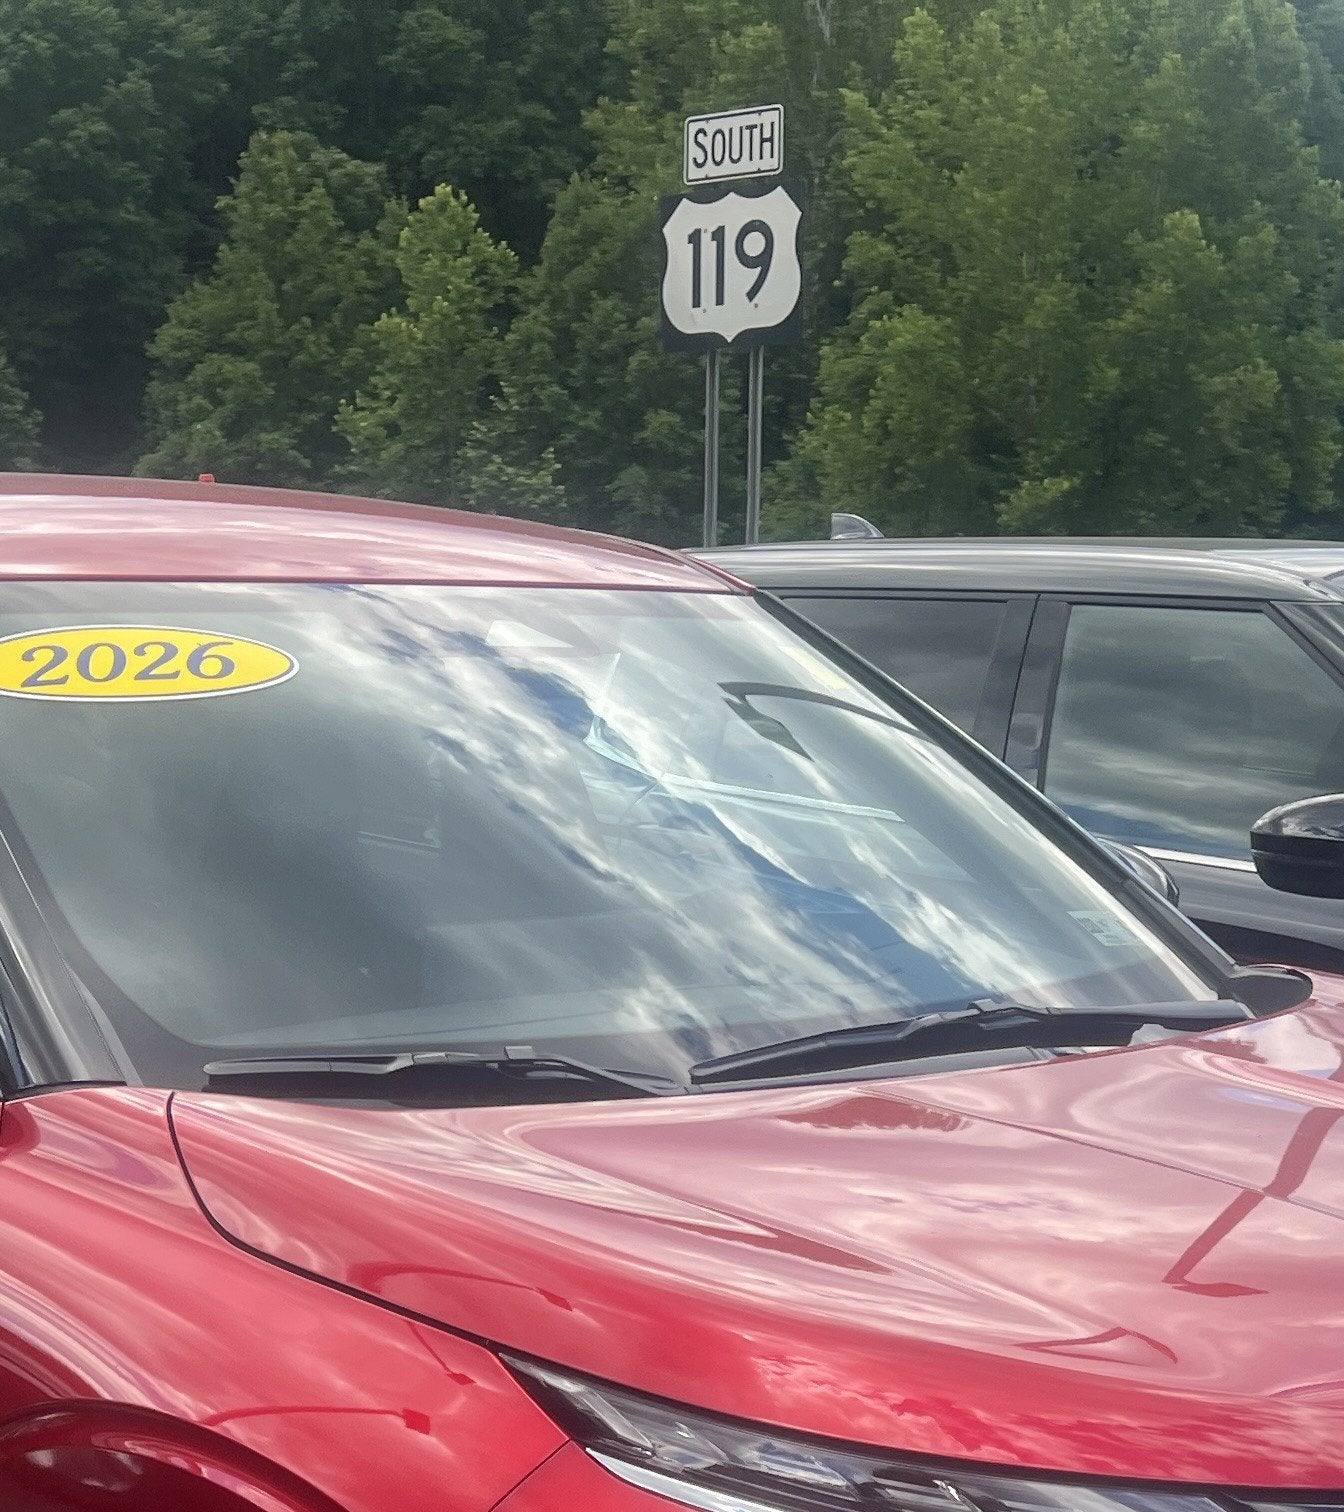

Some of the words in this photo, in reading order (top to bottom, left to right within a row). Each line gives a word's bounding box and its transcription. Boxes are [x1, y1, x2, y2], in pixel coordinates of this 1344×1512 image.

[692, 121, 775, 169] SOUTH
[687, 219, 774, 309] 119
[20, 641, 236, 688] 2026
